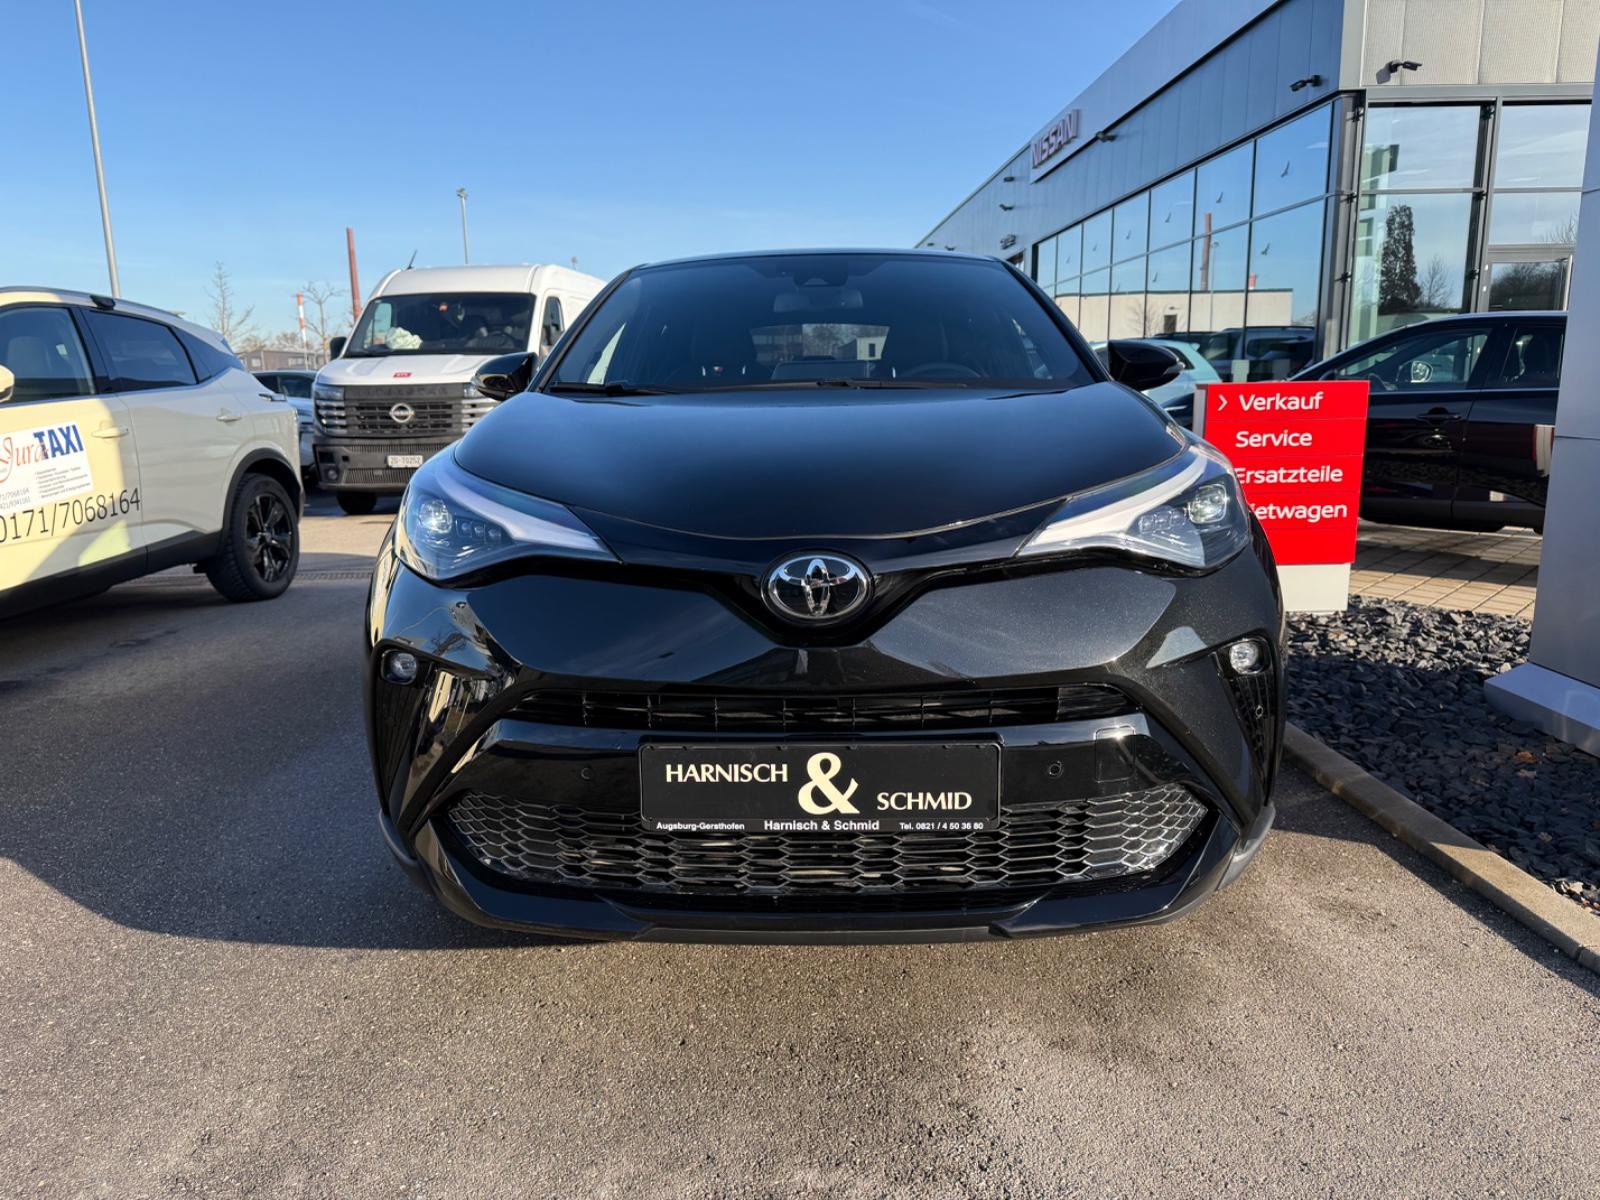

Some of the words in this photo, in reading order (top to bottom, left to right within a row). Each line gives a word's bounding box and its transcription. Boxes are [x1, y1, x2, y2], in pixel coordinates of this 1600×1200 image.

[1032, 109, 1080, 169] NISSAN
[1239, 391, 1324, 411] Verkauf
[32, 424, 84, 460] TAXI
[1235, 429, 1312, 448] Service
[1234, 465, 1343, 483] Ersatzteile
[0, 487, 141, 543] 0171/7068164
[1250, 503, 1347, 522] ietwagen
[665, 763, 788, 783] HARNISCH
[797, 752, 860, 815] &
[876, 792, 972, 811] SCHMID
[656, 821, 745, 832] Augsburg-Gersthofen
[764, 819, 818, 831] Harnisch
[821, 820, 830, 831] &
[833, 819, 880, 831] Schmid
[899, 822, 914, 830] Tel.
[915, 822, 935, 830] 0821
[942, 822, 948, 830] 4
[949, 822, 960, 830] 50
